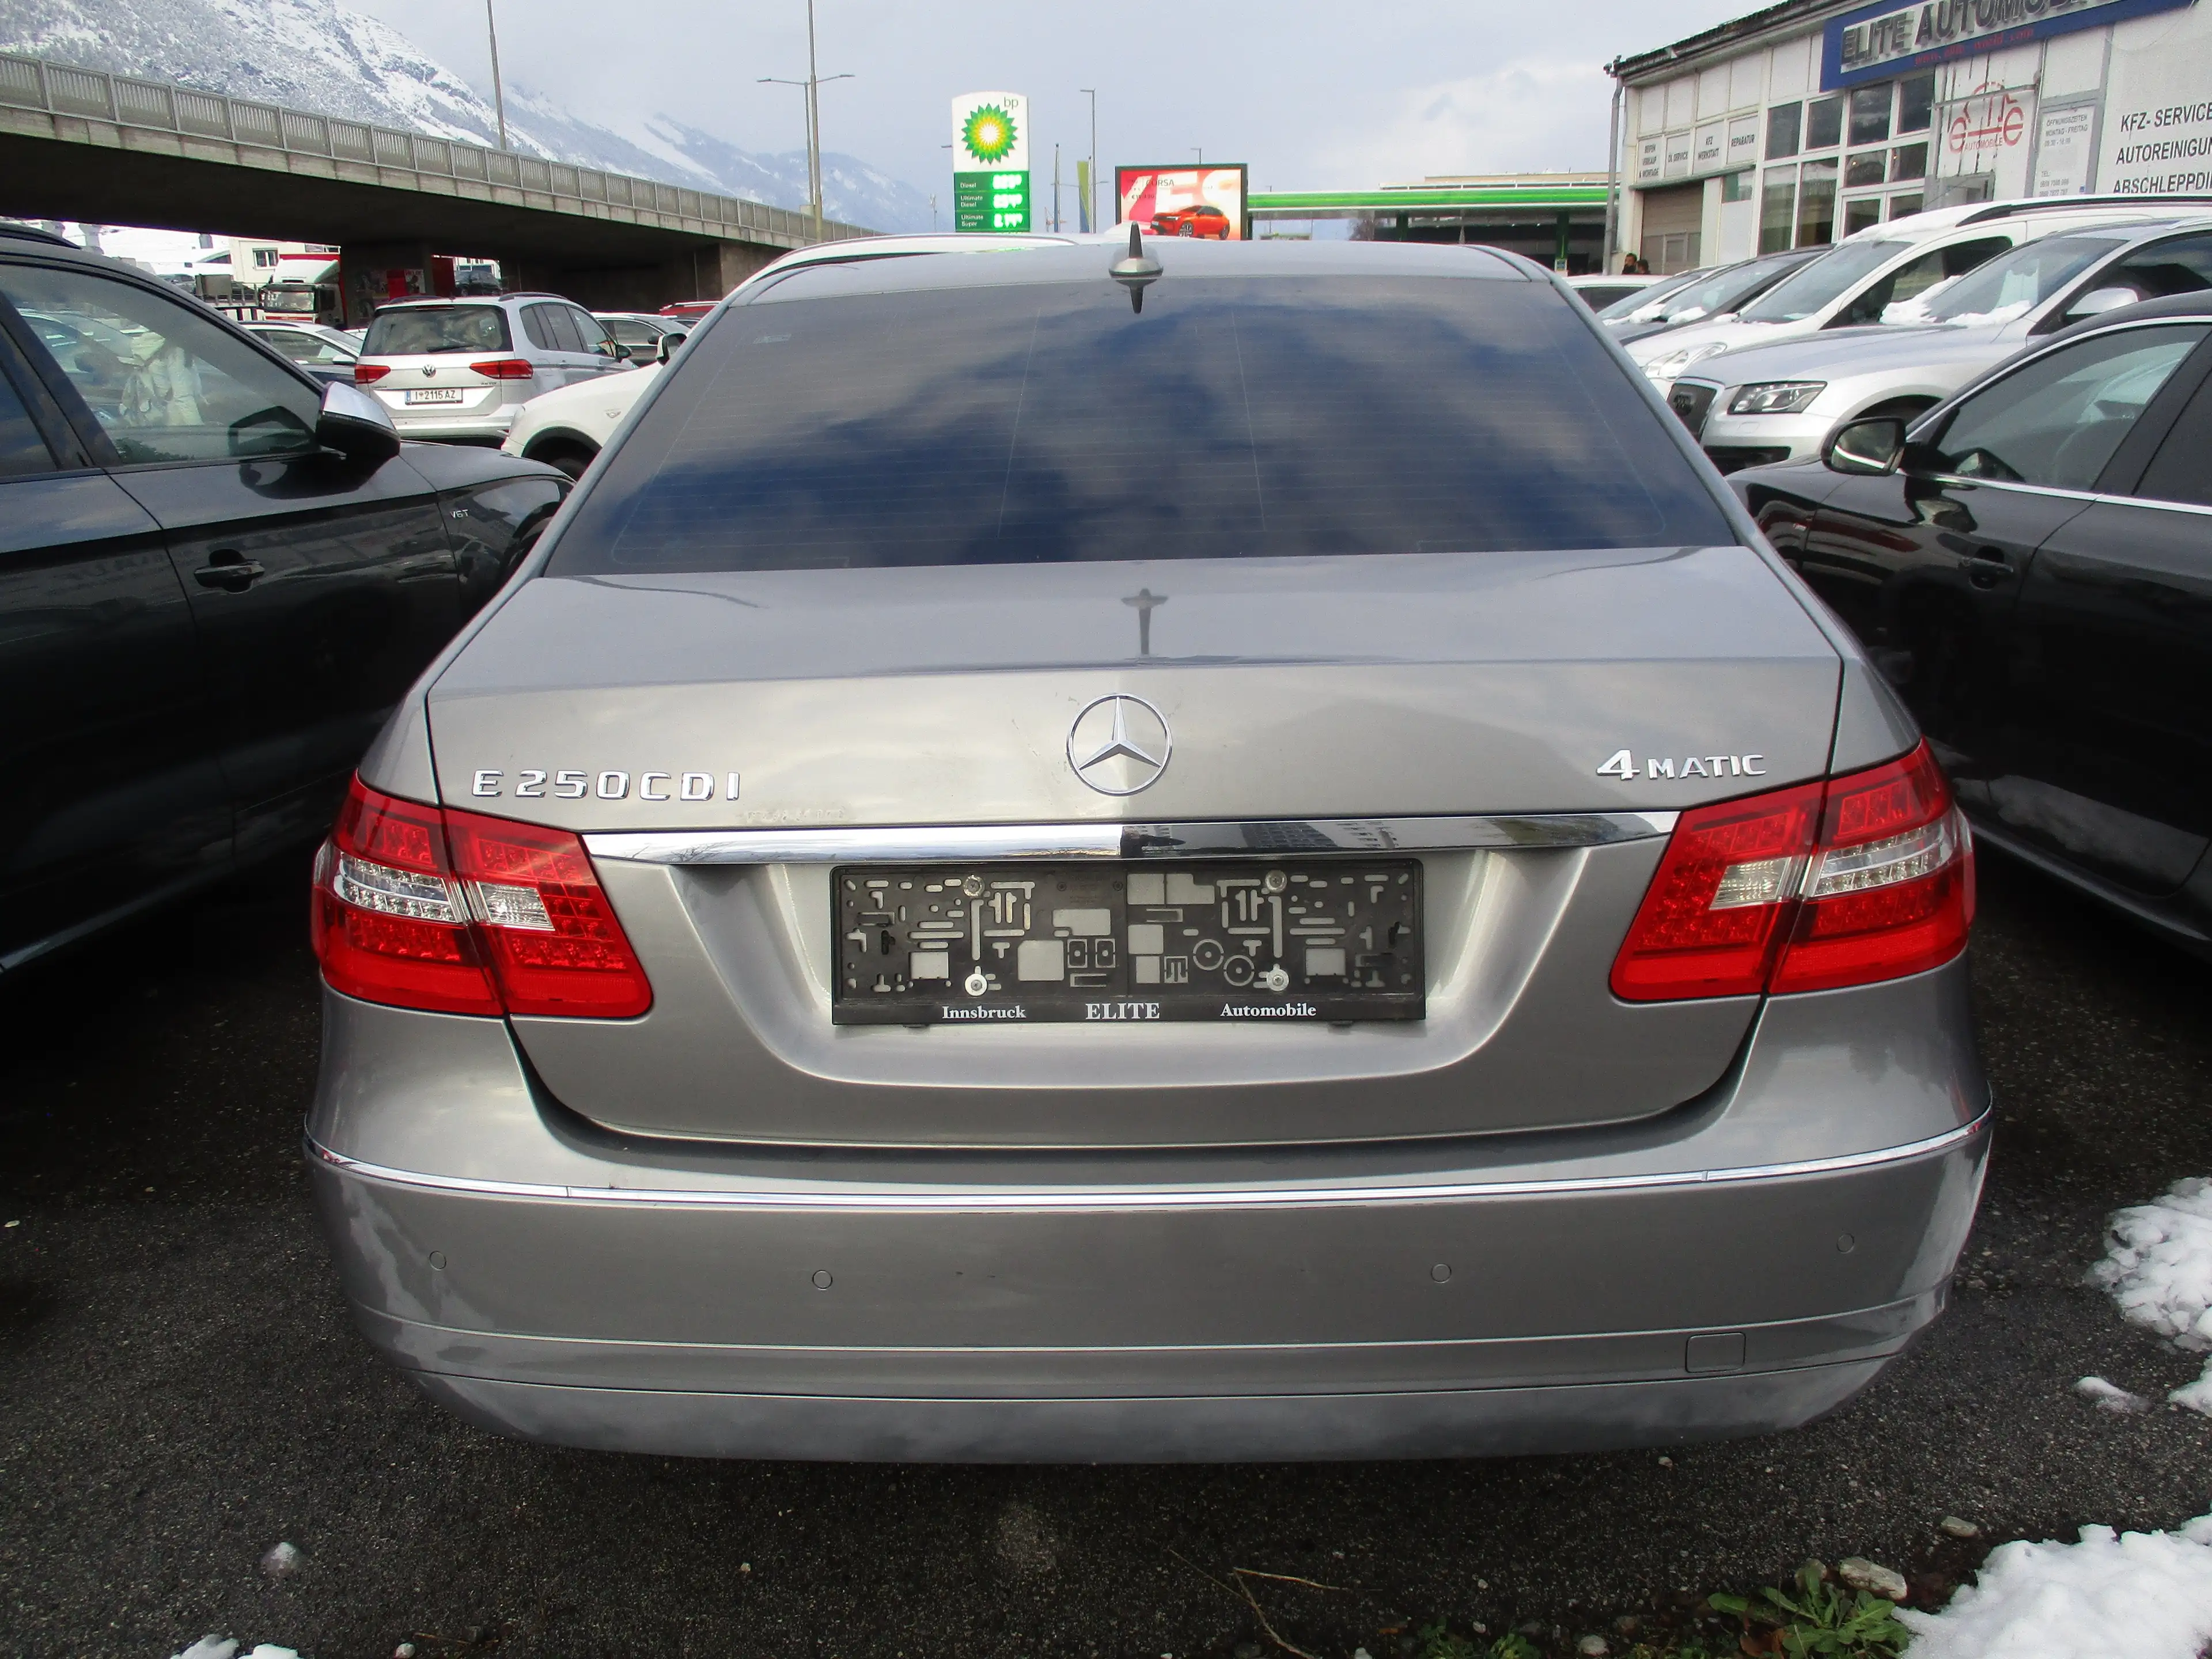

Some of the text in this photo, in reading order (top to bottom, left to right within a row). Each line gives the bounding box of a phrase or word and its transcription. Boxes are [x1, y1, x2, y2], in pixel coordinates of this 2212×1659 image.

[1843, 12, 1910, 65] ELITE
[1004, 96, 1018, 110] bp
[450, 509, 468, 518] V6T
[942, 1003, 1317, 1020] Innsbruck ELITE Automobile
